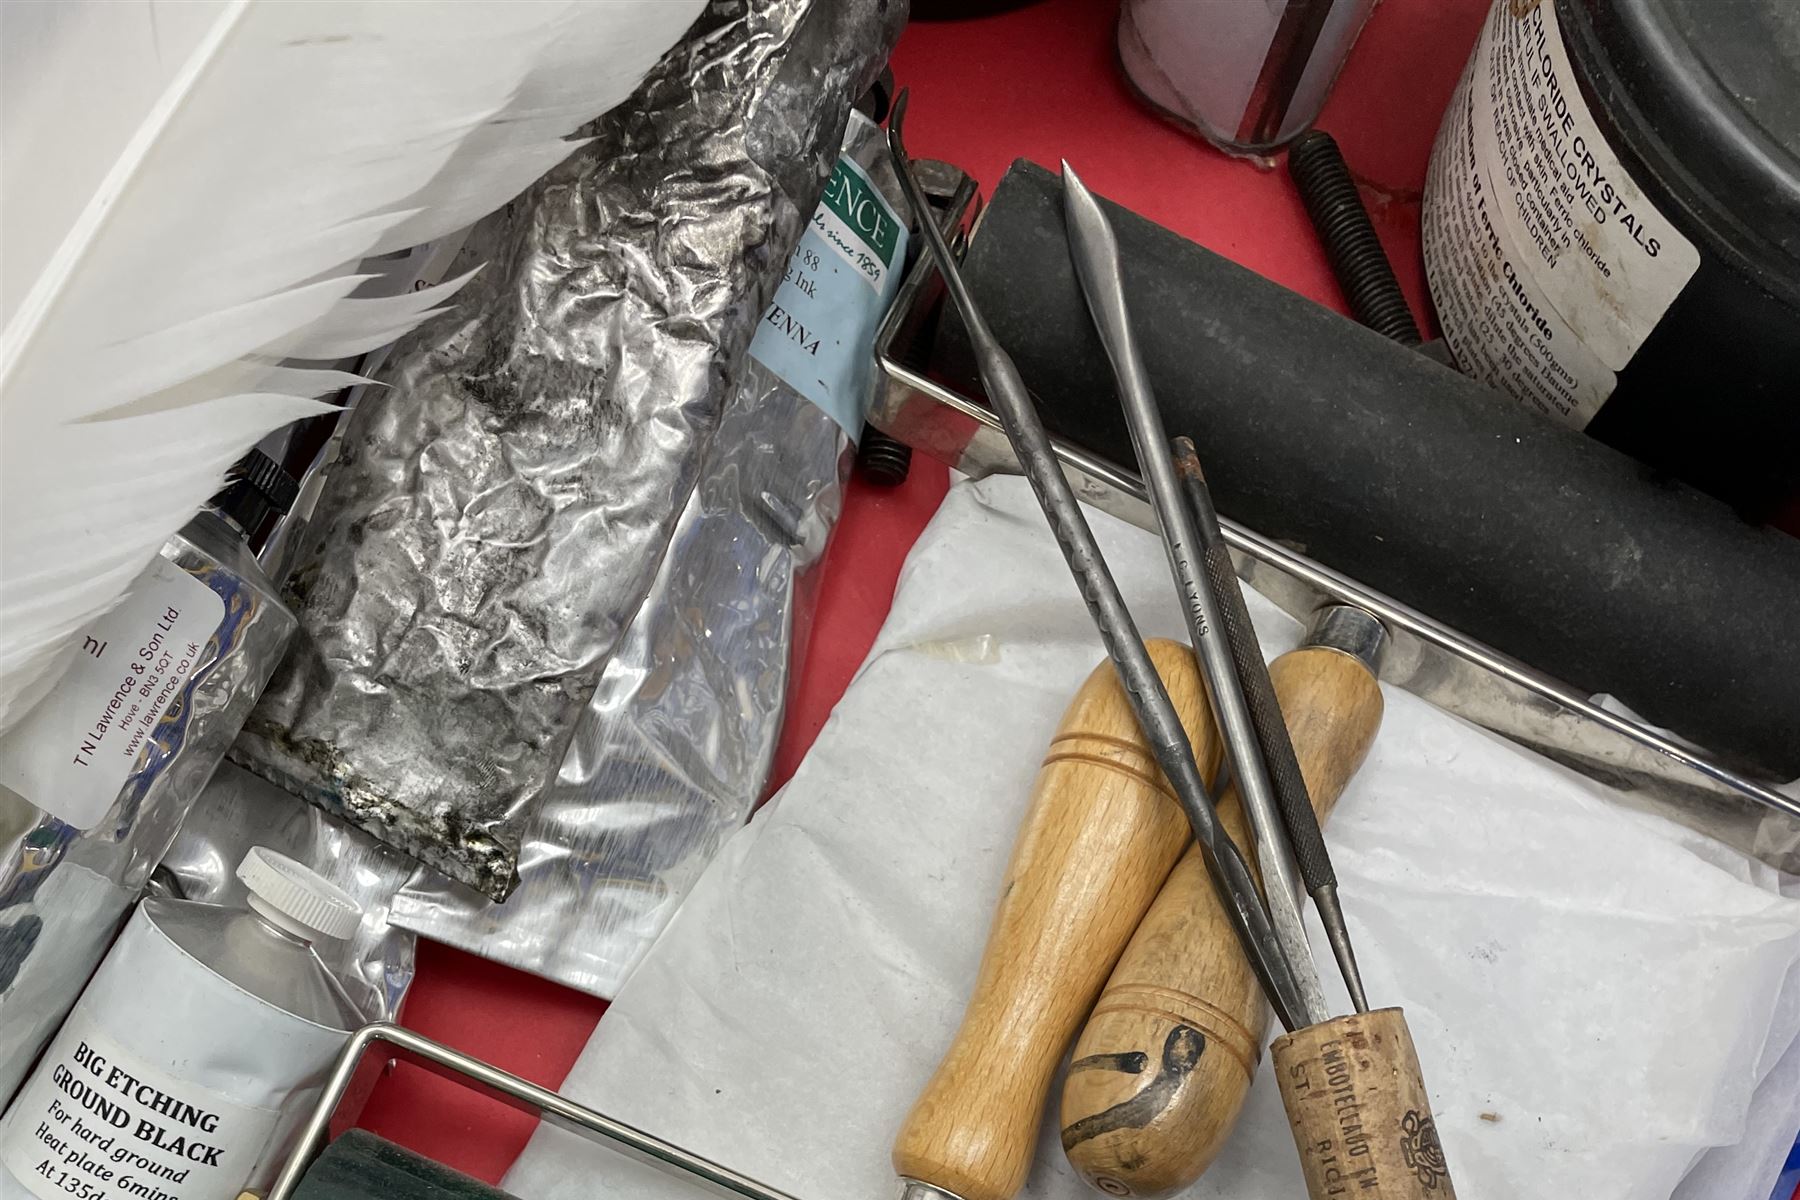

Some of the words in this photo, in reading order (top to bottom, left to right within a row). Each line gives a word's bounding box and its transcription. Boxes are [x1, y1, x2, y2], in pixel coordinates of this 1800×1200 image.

[1502, 114, 1513, 145] well
[1509, 145, 1528, 192] closed
[1517, 51, 1537, 127] immediate
[1535, 126, 1562, 183] medical
[1531, 68, 1542, 89] IF
[1538, 94, 1606, 225] SWALLOWED
[1533, 3, 1576, 137] CHLORIDE
[1573, 136, 1662, 258] CRYSTALS
[823, 166, 888, 249] ENCE
[1492, 107, 1509, 167] REACH
[1506, 166, 1518, 188] OF
[1515, 192, 1557, 269] CHILDREN
[1512, 69, 1526, 122] contact
[1523, 121, 1536, 153] with
[1549, 186, 1574, 228] Ferric
[1573, 228, 1612, 279] chloride
[1523, 160, 1562, 234] particularly
[1560, 231, 1572, 249] in
[803, 249, 821, 273] 88
[827, 230, 855, 258] since
[1472, 173, 1482, 196] of
[1478, 196, 1504, 261] Ferric
[1502, 261, 1553, 342] Chloride
[795, 272, 817, 299] Ink
[1487, 259, 1500, 284] the
[1499, 285, 1530, 335] crystals
[1529, 333, 1579, 391] (500gms)
[766, 303, 821, 356] ENNA
[1484, 306, 1508, 345] dilute
[1507, 343, 1523, 367] the
[1522, 366, 1572, 417] saturated
[1505, 320, 1541, 369] degrees
[1512, 372, 1550, 416] degrees
[131, 663, 145, 675] &
[139, 633, 164, 661] Son
[88, 676, 137, 741] Lawrence
[118, 704, 140, 732] Hove
[139, 674, 160, 699] BN3
[155, 651, 175, 676] 5QT
[123, 641, 200, 758] www.lawrence.co.uk
[73, 754, 89, 768] T
[80, 740, 97, 756] N
[53, 1063, 131, 1130] GROUND
[133, 1118, 225, 1167] BLACK
[73, 1041, 107, 1077] BIG
[105, 1066, 220, 1133] ETCHING
[35, 1121, 69, 1156] Heat
[64, 1149, 114, 1182] plate
[35, 1159, 57, 1179] At
[48, 1099, 72, 1125] For
[70, 1117, 115, 1153] hard
[110, 1148, 190, 1184] ground
[1354, 1164, 1379, 1190] EN
